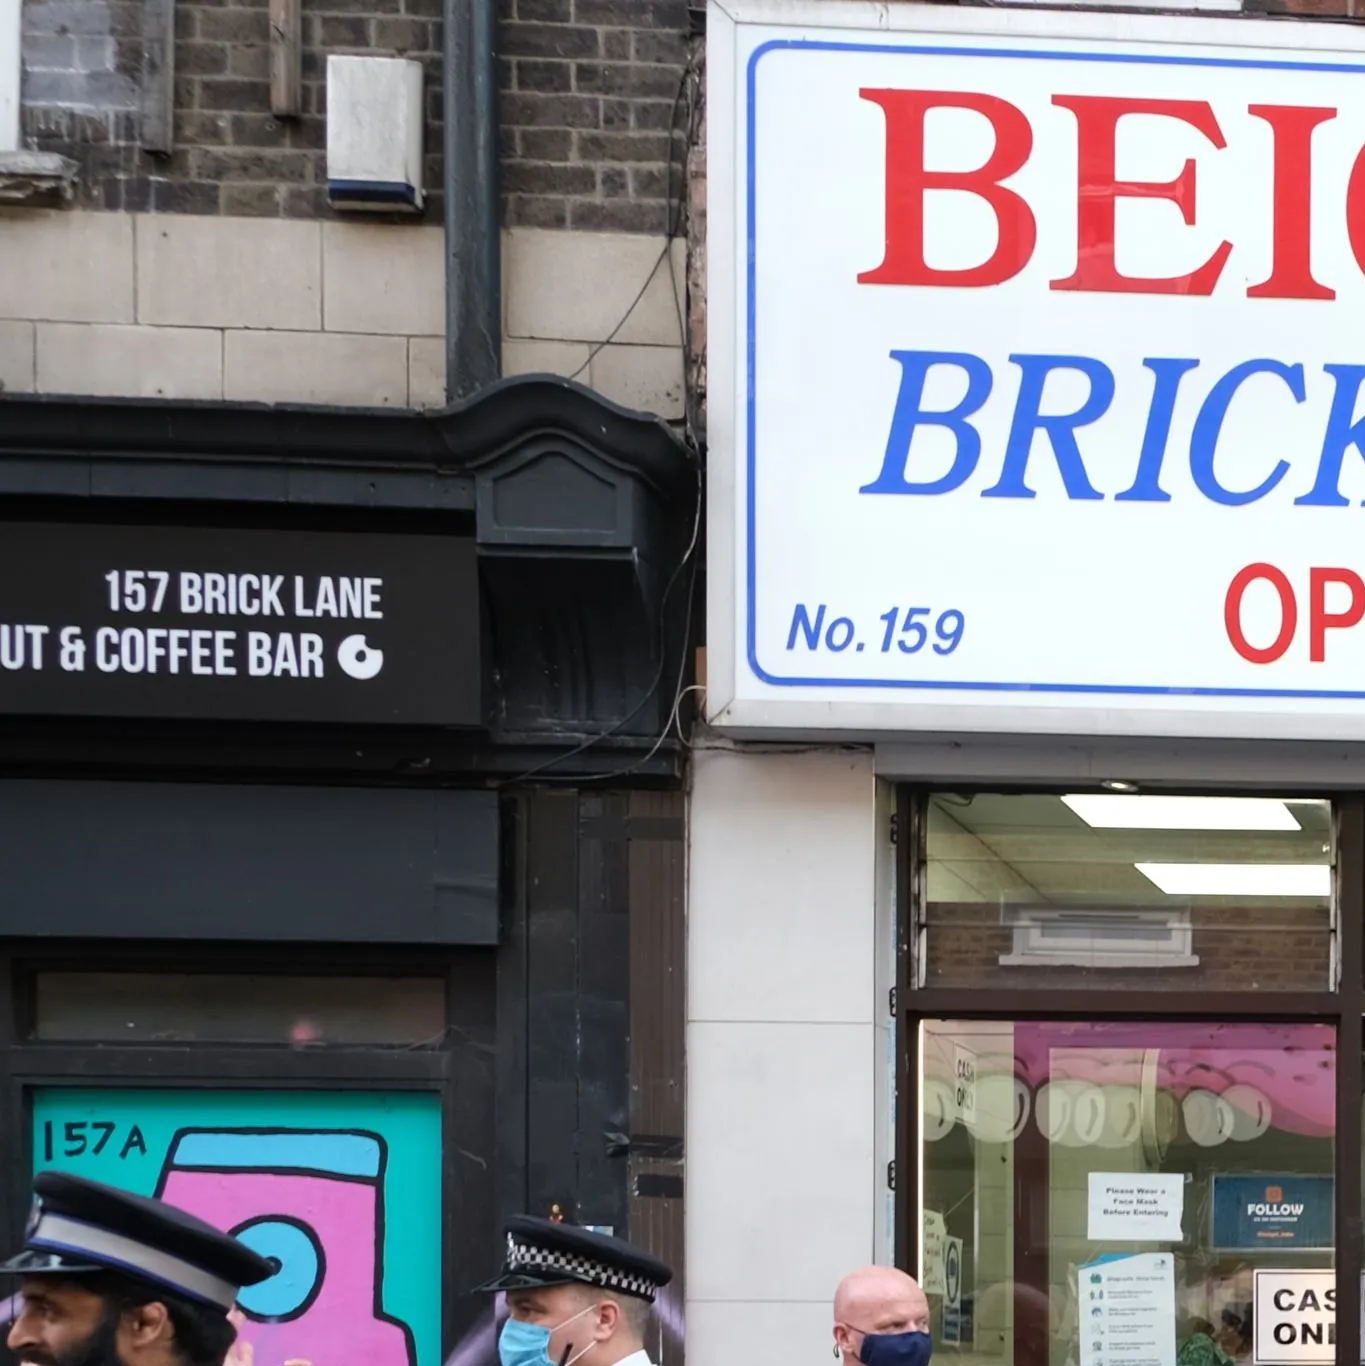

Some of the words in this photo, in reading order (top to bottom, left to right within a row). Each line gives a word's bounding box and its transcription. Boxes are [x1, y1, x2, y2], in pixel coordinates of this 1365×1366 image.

[104, 570, 169, 614] 157
[180, 573, 284, 617] BRICK
[294, 576, 383, 620] LANE
[0, 624, 49, 670] UT
[59, 626, 87, 672] &
[96, 628, 237, 677] COFFEE
[248, 632, 325, 679] BAR
[43, 1120, 148, 1161] 157A
[1106, 1186, 1135, 1195] Please
[1137, 1187, 1160, 1195] Wear
[1113, 1197, 1134, 1206] Face
[1136, 1197, 1158, 1206] Mask
[1102, 1208, 1131, 1217] Before
[1133, 1208, 1169, 1218] Entering
[1247, 1203, 1304, 1216] FOLLOW
